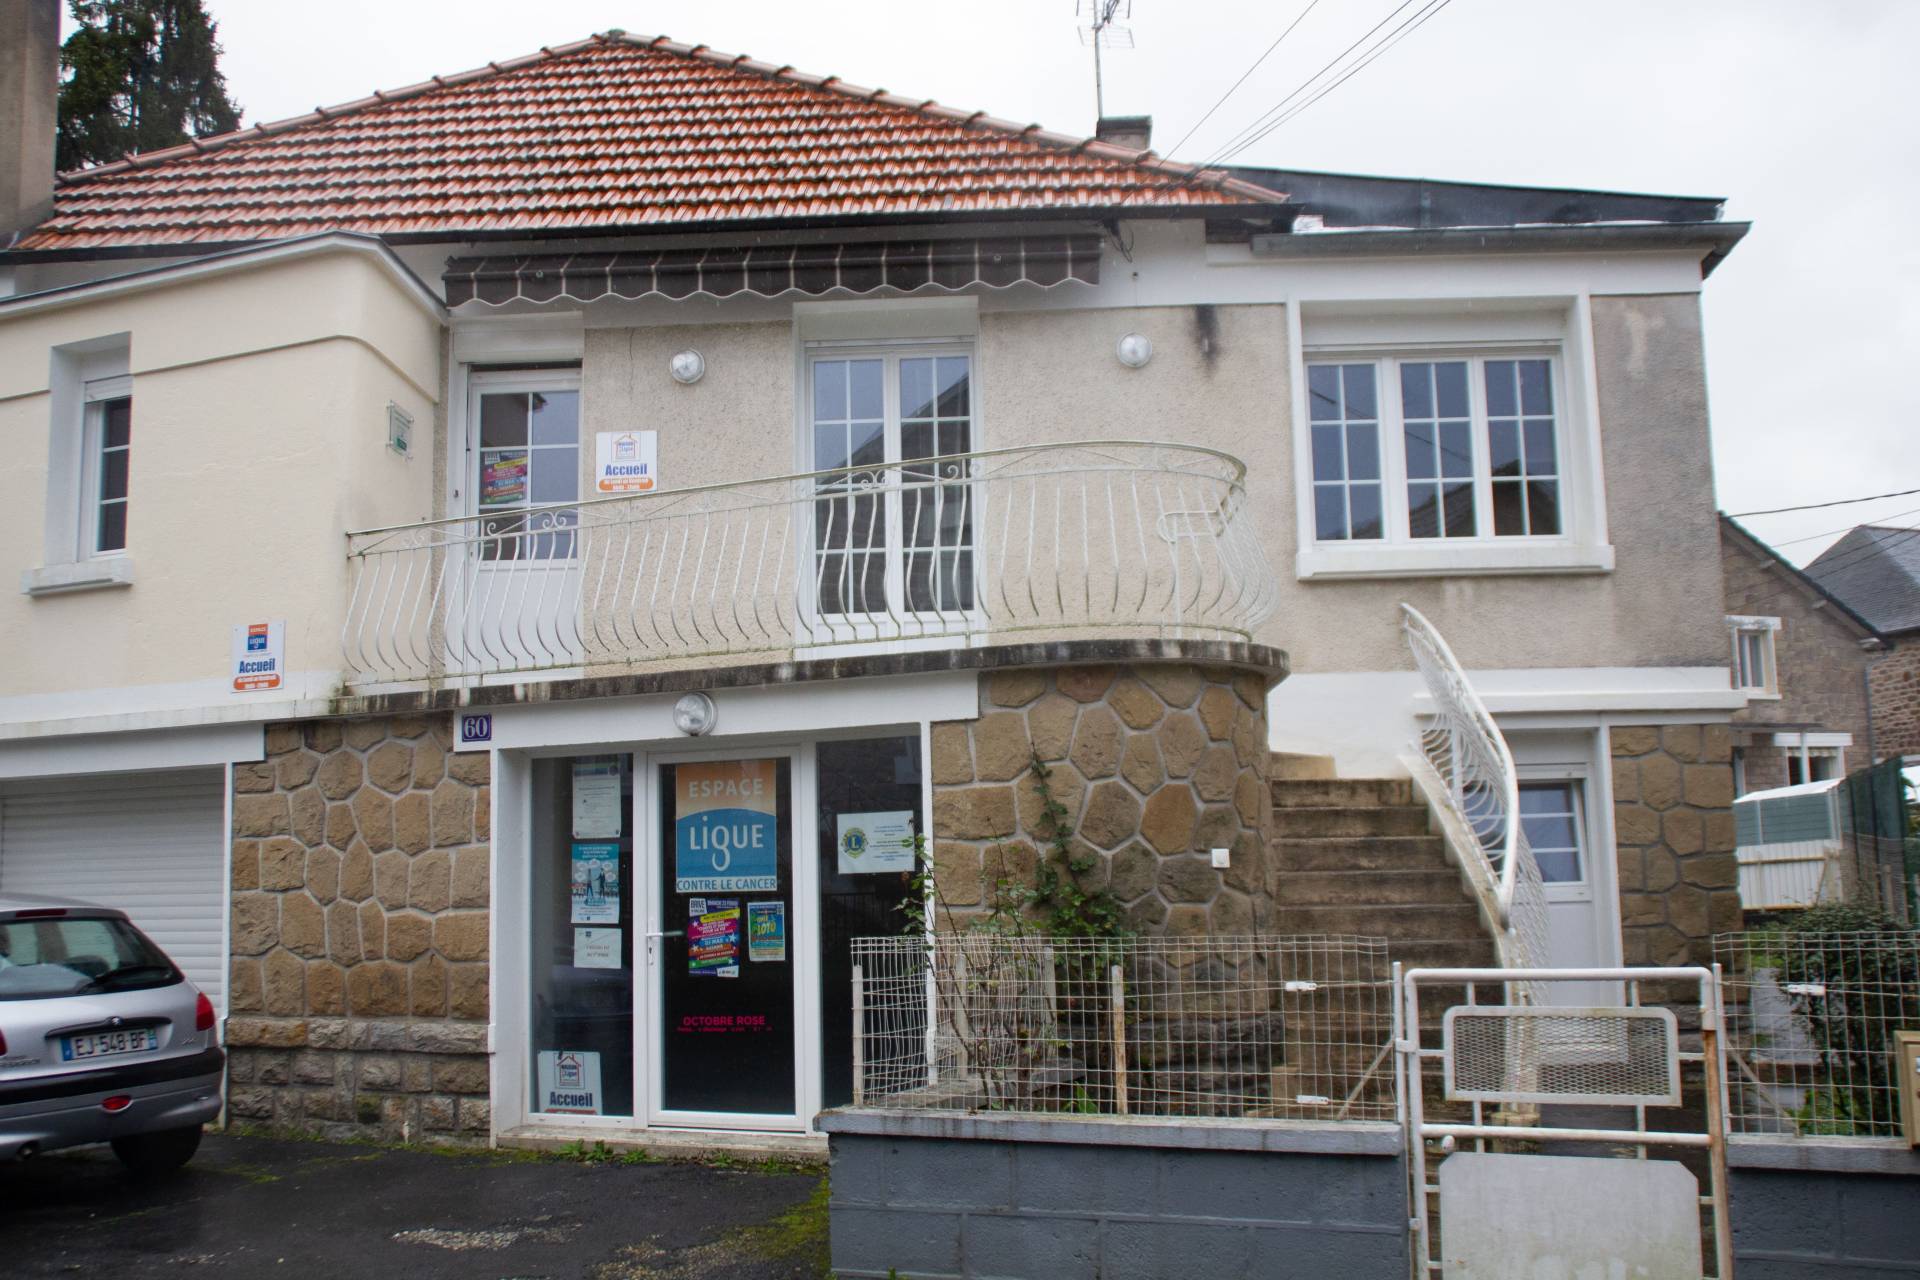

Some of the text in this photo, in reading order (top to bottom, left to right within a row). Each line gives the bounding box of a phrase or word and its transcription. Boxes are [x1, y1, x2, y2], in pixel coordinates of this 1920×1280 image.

[605, 463, 648, 476] Accueil
[239, 658, 275, 673] Accueil
[464, 717, 488, 738] 60
[688, 778, 763, 799] ESPACE
[677, 878, 776, 891] CONTRE LE CANCER
[683, 1015, 765, 1026] OCTOBRE ROSE
[550, 1091, 593, 1107] Accueil
